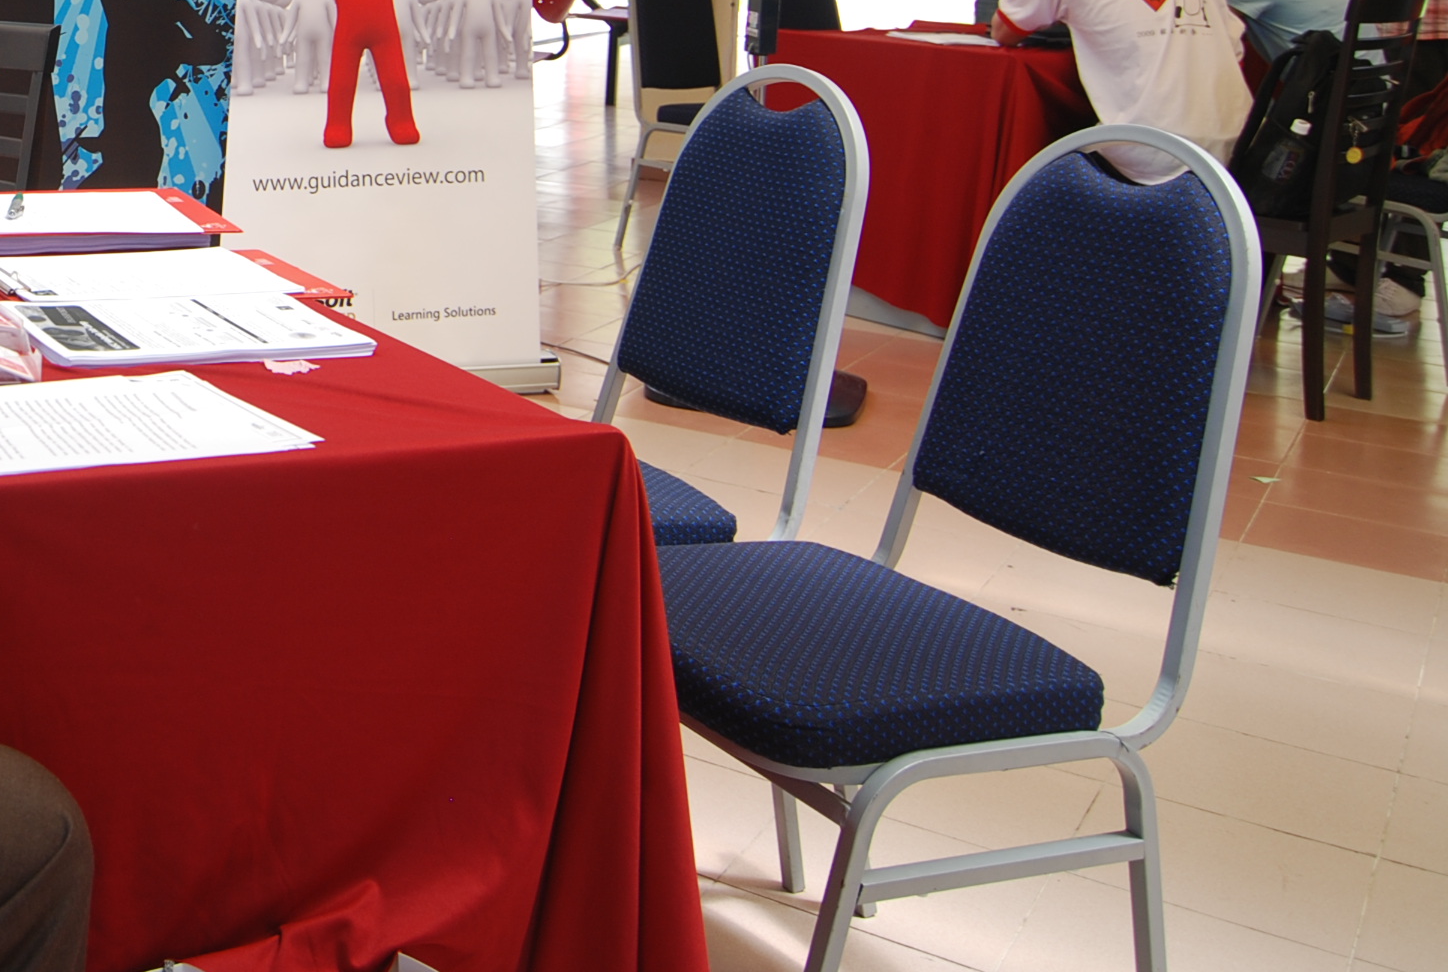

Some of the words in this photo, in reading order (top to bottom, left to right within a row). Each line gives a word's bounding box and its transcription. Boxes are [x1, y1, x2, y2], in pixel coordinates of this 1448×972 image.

[253, 167, 486, 195] www.guidanceview.com
[391, 308, 441, 322] Learning
[443, 304, 497, 319] Solutions
